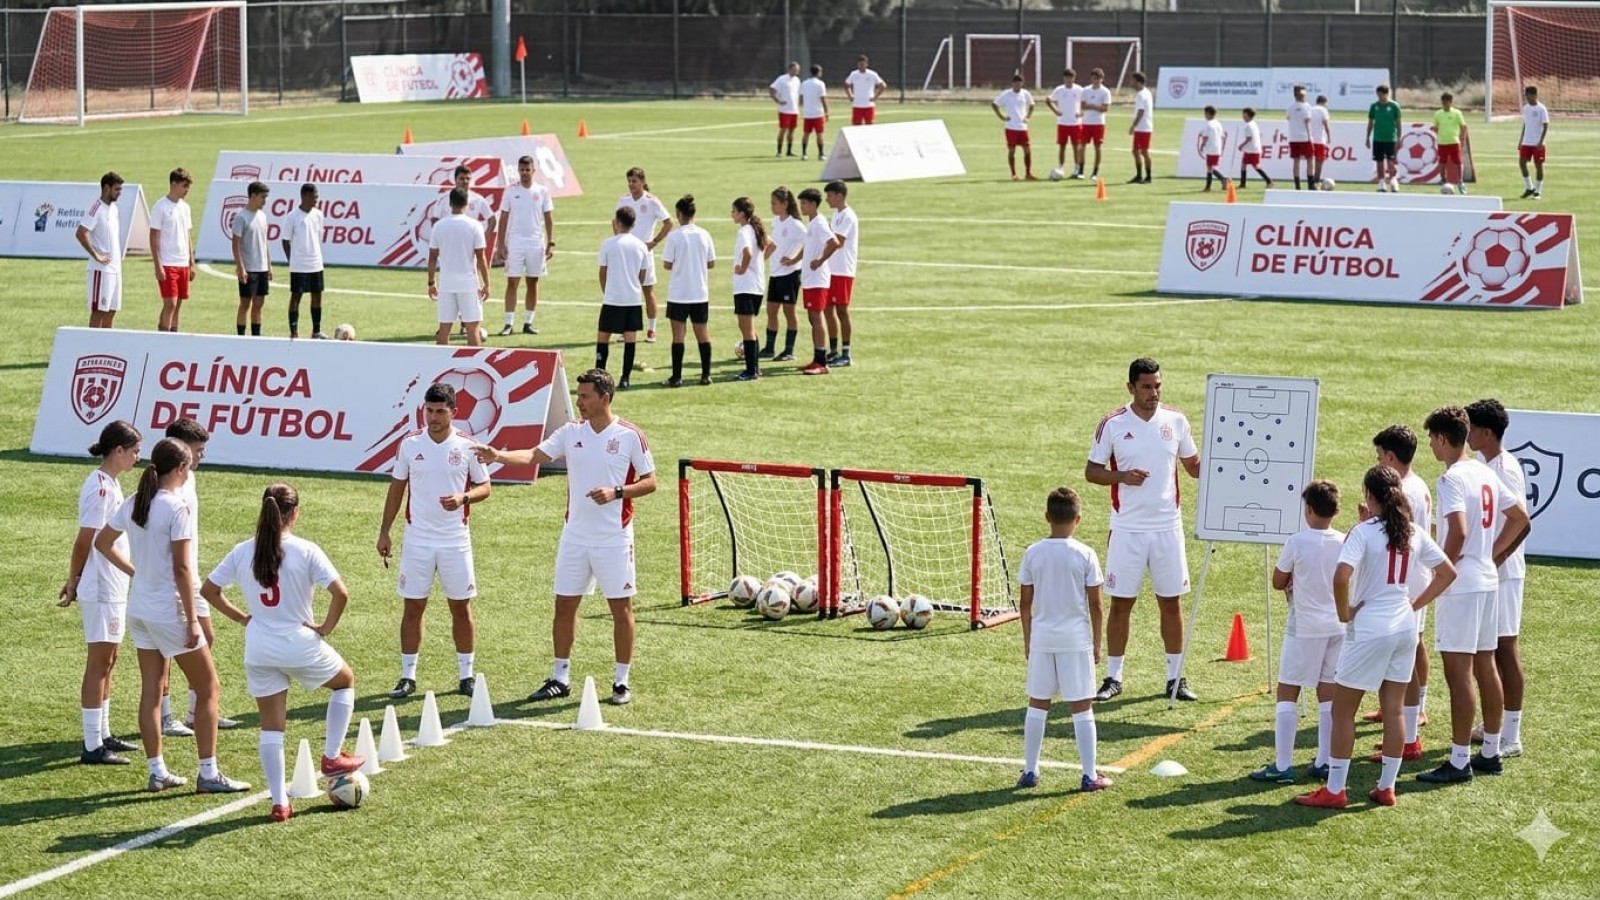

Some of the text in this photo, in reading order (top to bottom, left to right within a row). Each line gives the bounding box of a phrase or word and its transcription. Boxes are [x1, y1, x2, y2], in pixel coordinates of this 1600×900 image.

[1255, 219, 1375, 250] CLÍNICA
[1251, 250, 1400, 279] DE FÚTBOL
[158, 355, 312, 399] CLÍNICA
[150, 397, 354, 442] DE FÚTBOL
[1481, 484, 1494, 530] 9
[1385, 541, 1410, 585] 11
